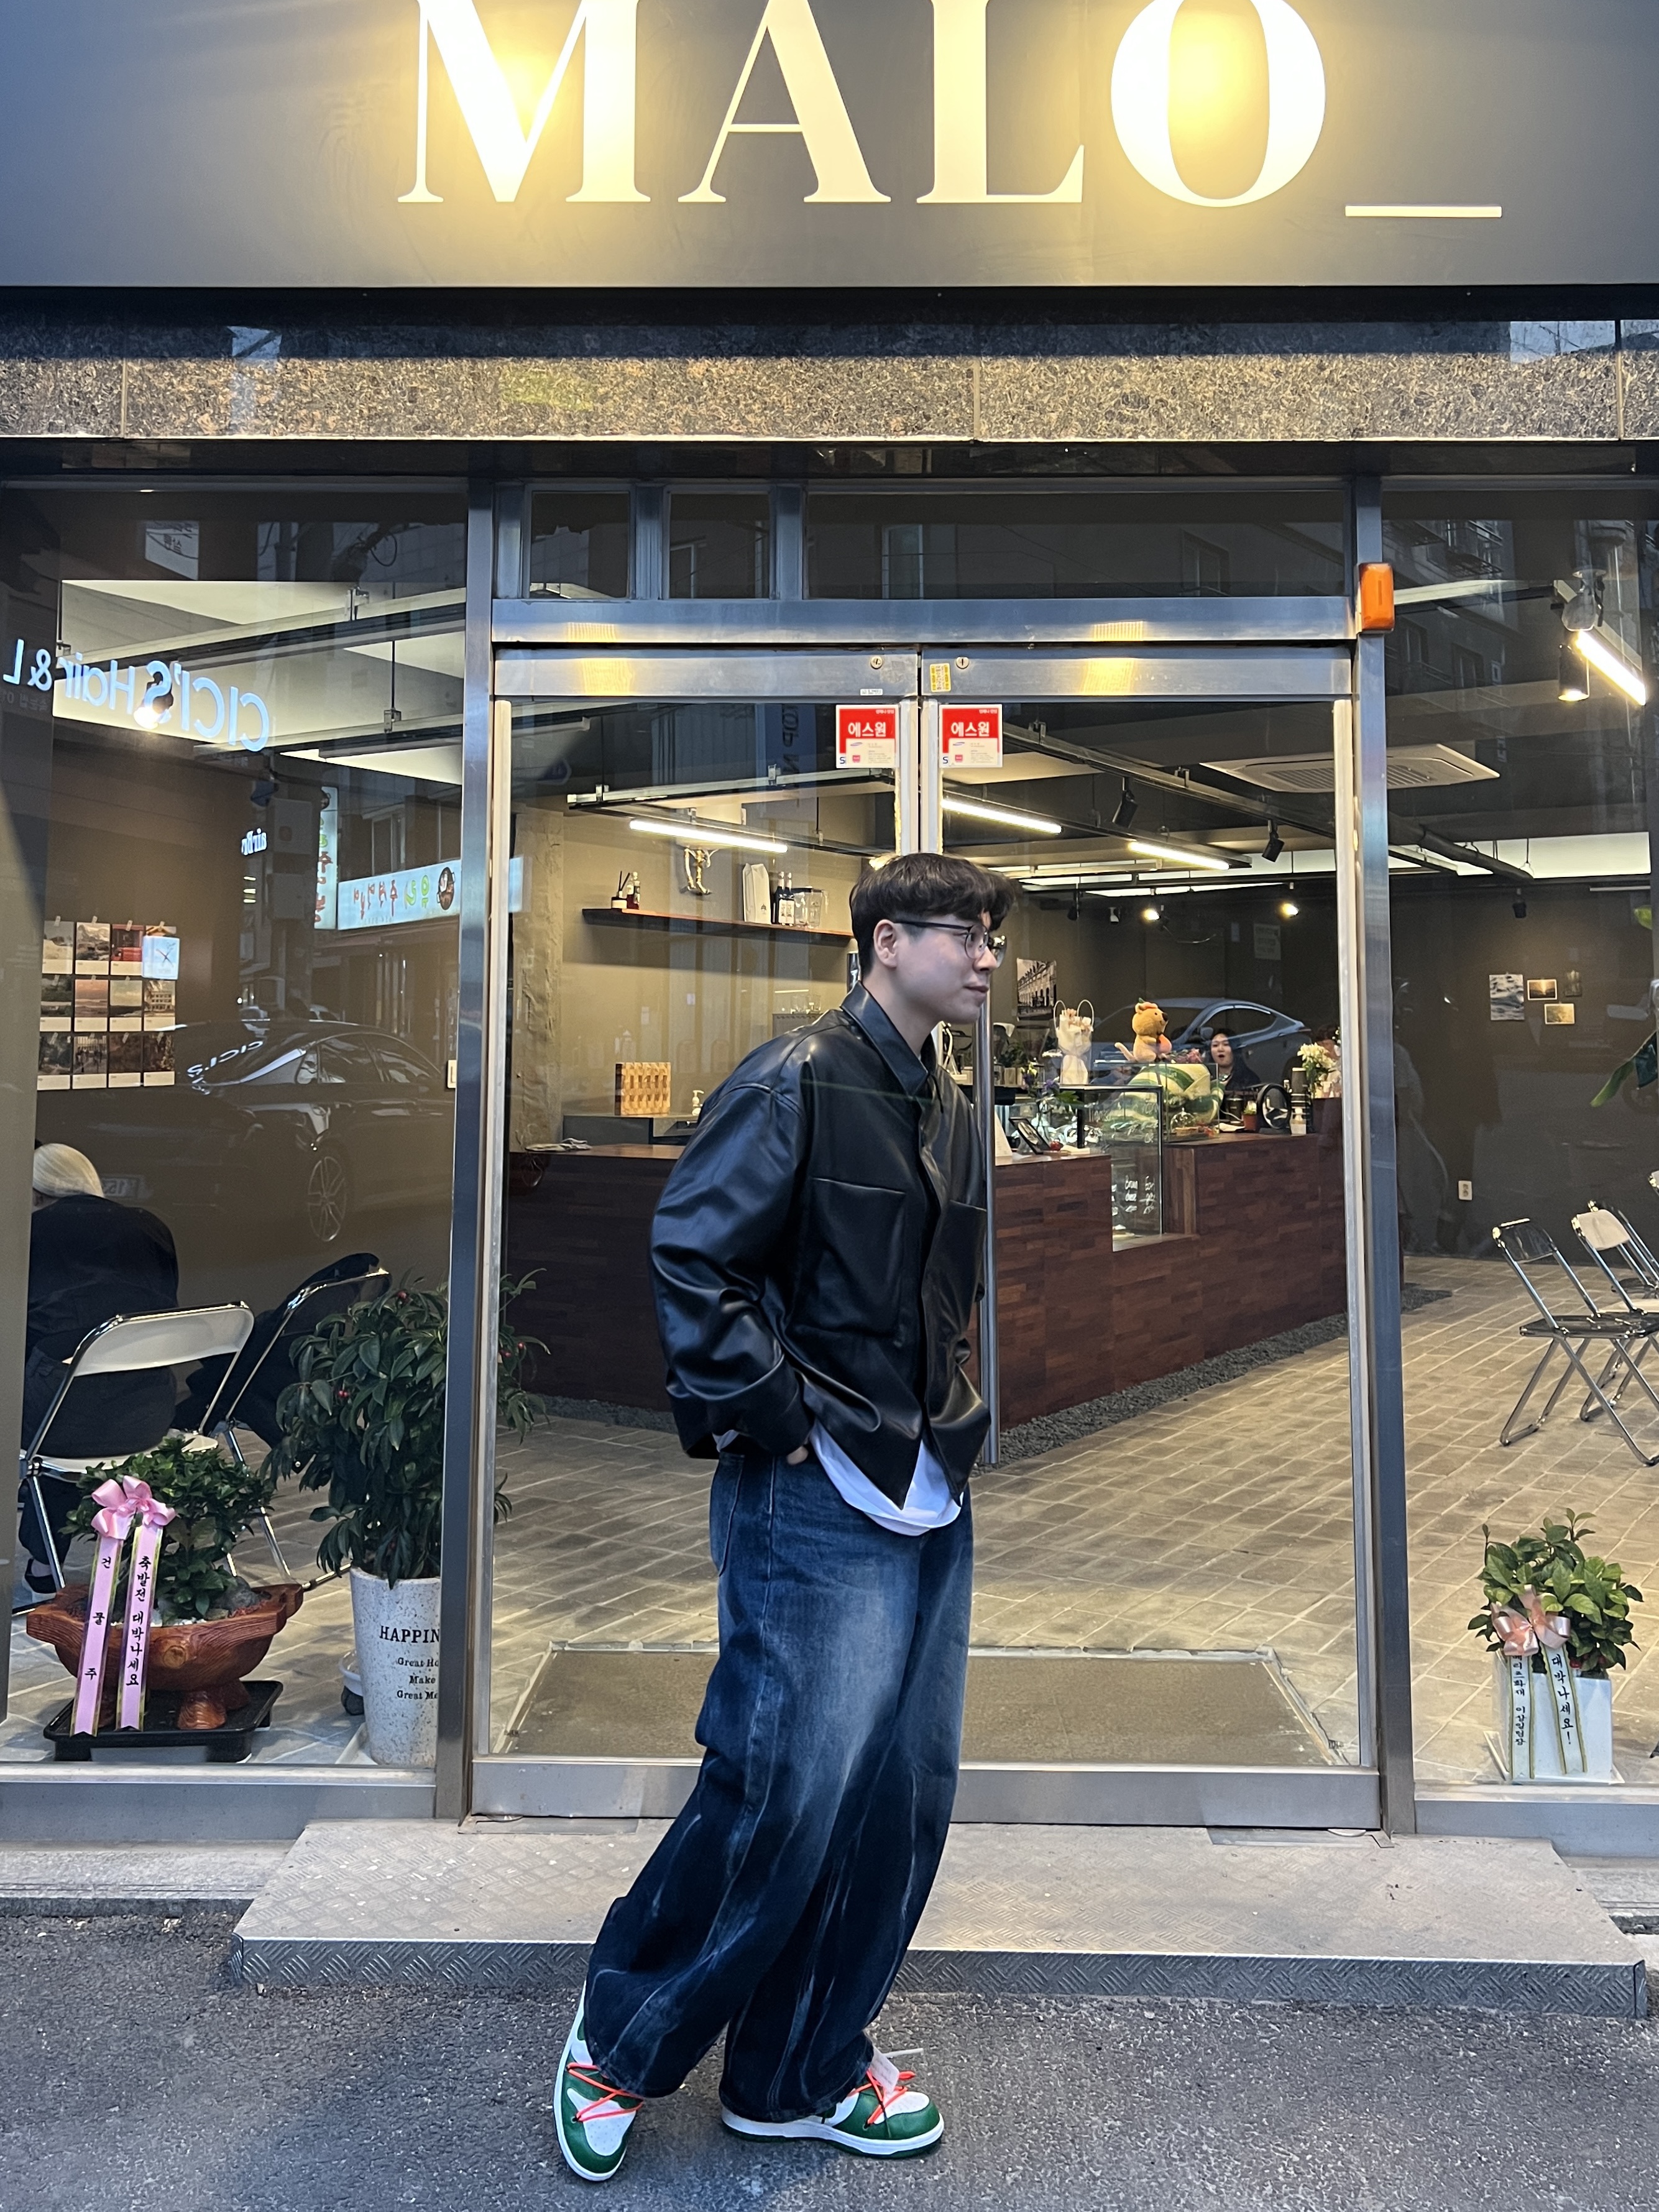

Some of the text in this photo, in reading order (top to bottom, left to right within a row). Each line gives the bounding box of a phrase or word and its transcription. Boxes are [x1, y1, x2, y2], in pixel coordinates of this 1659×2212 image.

[848, 722, 886, 738] 에스원
[951, 722, 990, 737] 에스원
[126, 1556, 151, 1686] 축발전 대박나세요
[398, 1657, 424, 1667] Great
[409, 1676, 435, 1684] Make
[397, 1690, 423, 1700] Great
[1551, 1654, 1574, 1745] 대박나세요!
